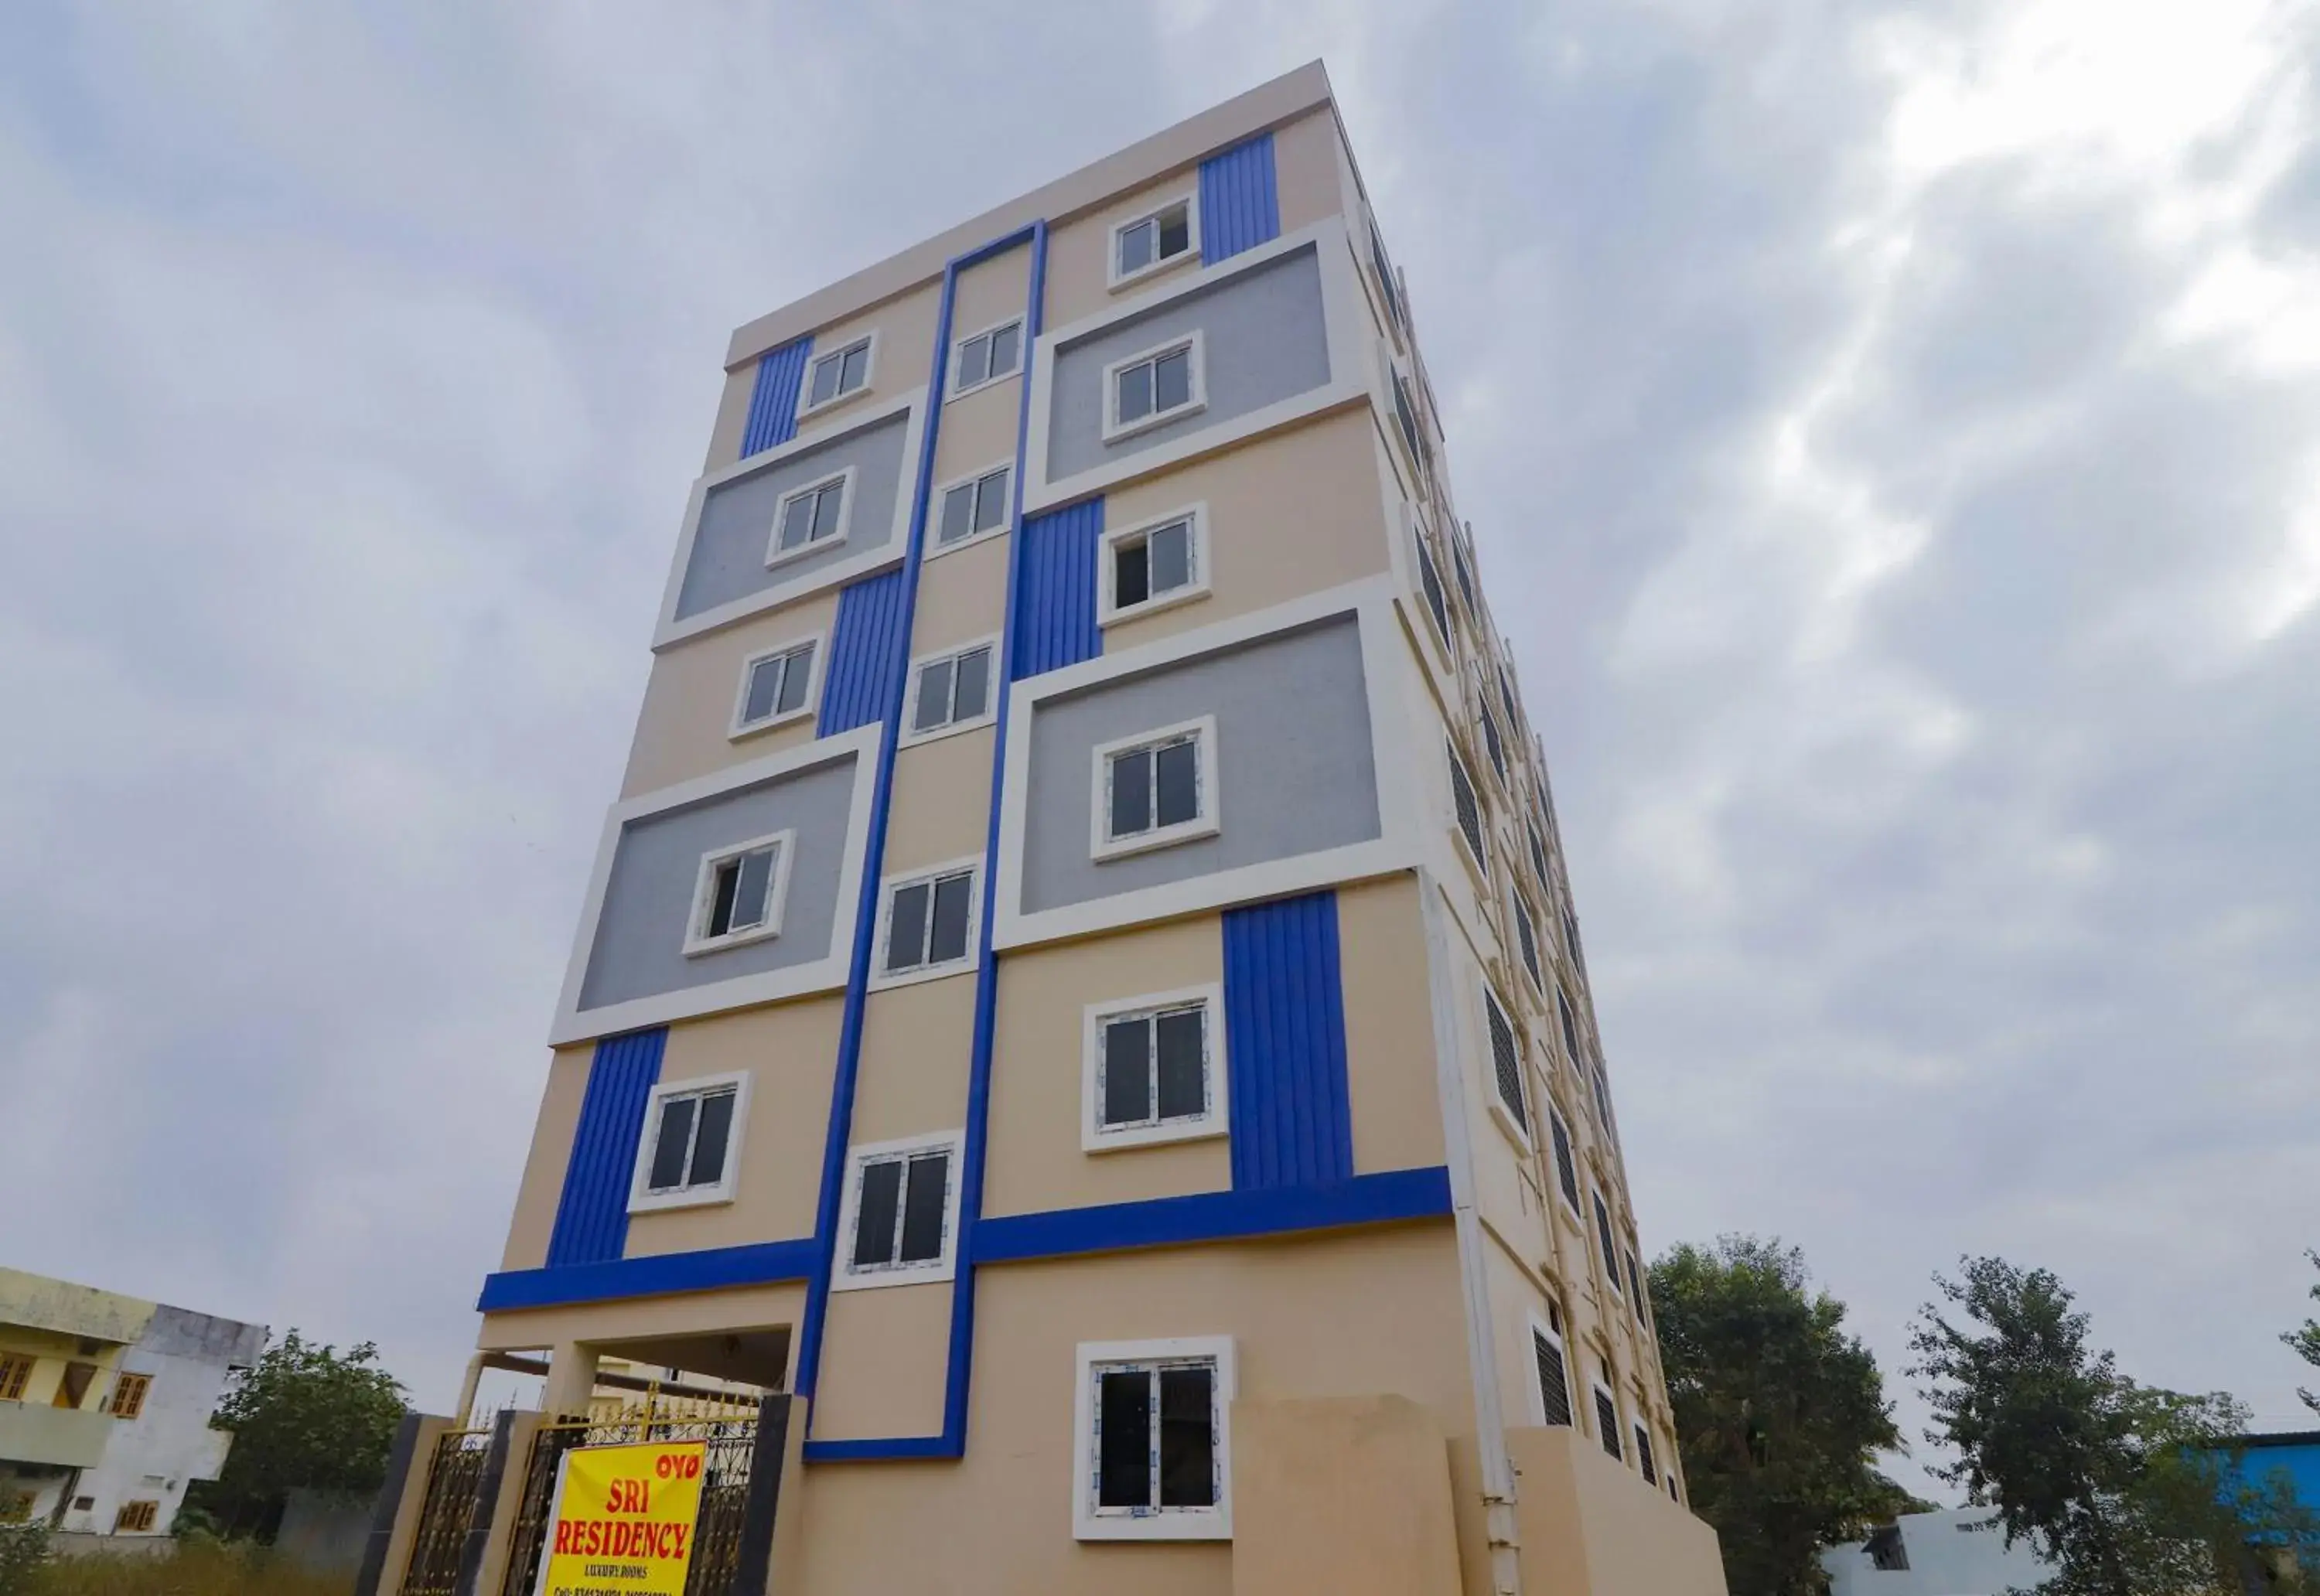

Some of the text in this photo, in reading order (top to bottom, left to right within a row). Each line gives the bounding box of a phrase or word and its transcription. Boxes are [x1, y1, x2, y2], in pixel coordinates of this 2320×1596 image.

[657, 1454, 699, 1478] OYO
[606, 1478, 650, 1513] SRI
[554, 1520, 689, 1559] RESIDENCY
[585, 1564, 648, 1579] LUXURY ROOMS
